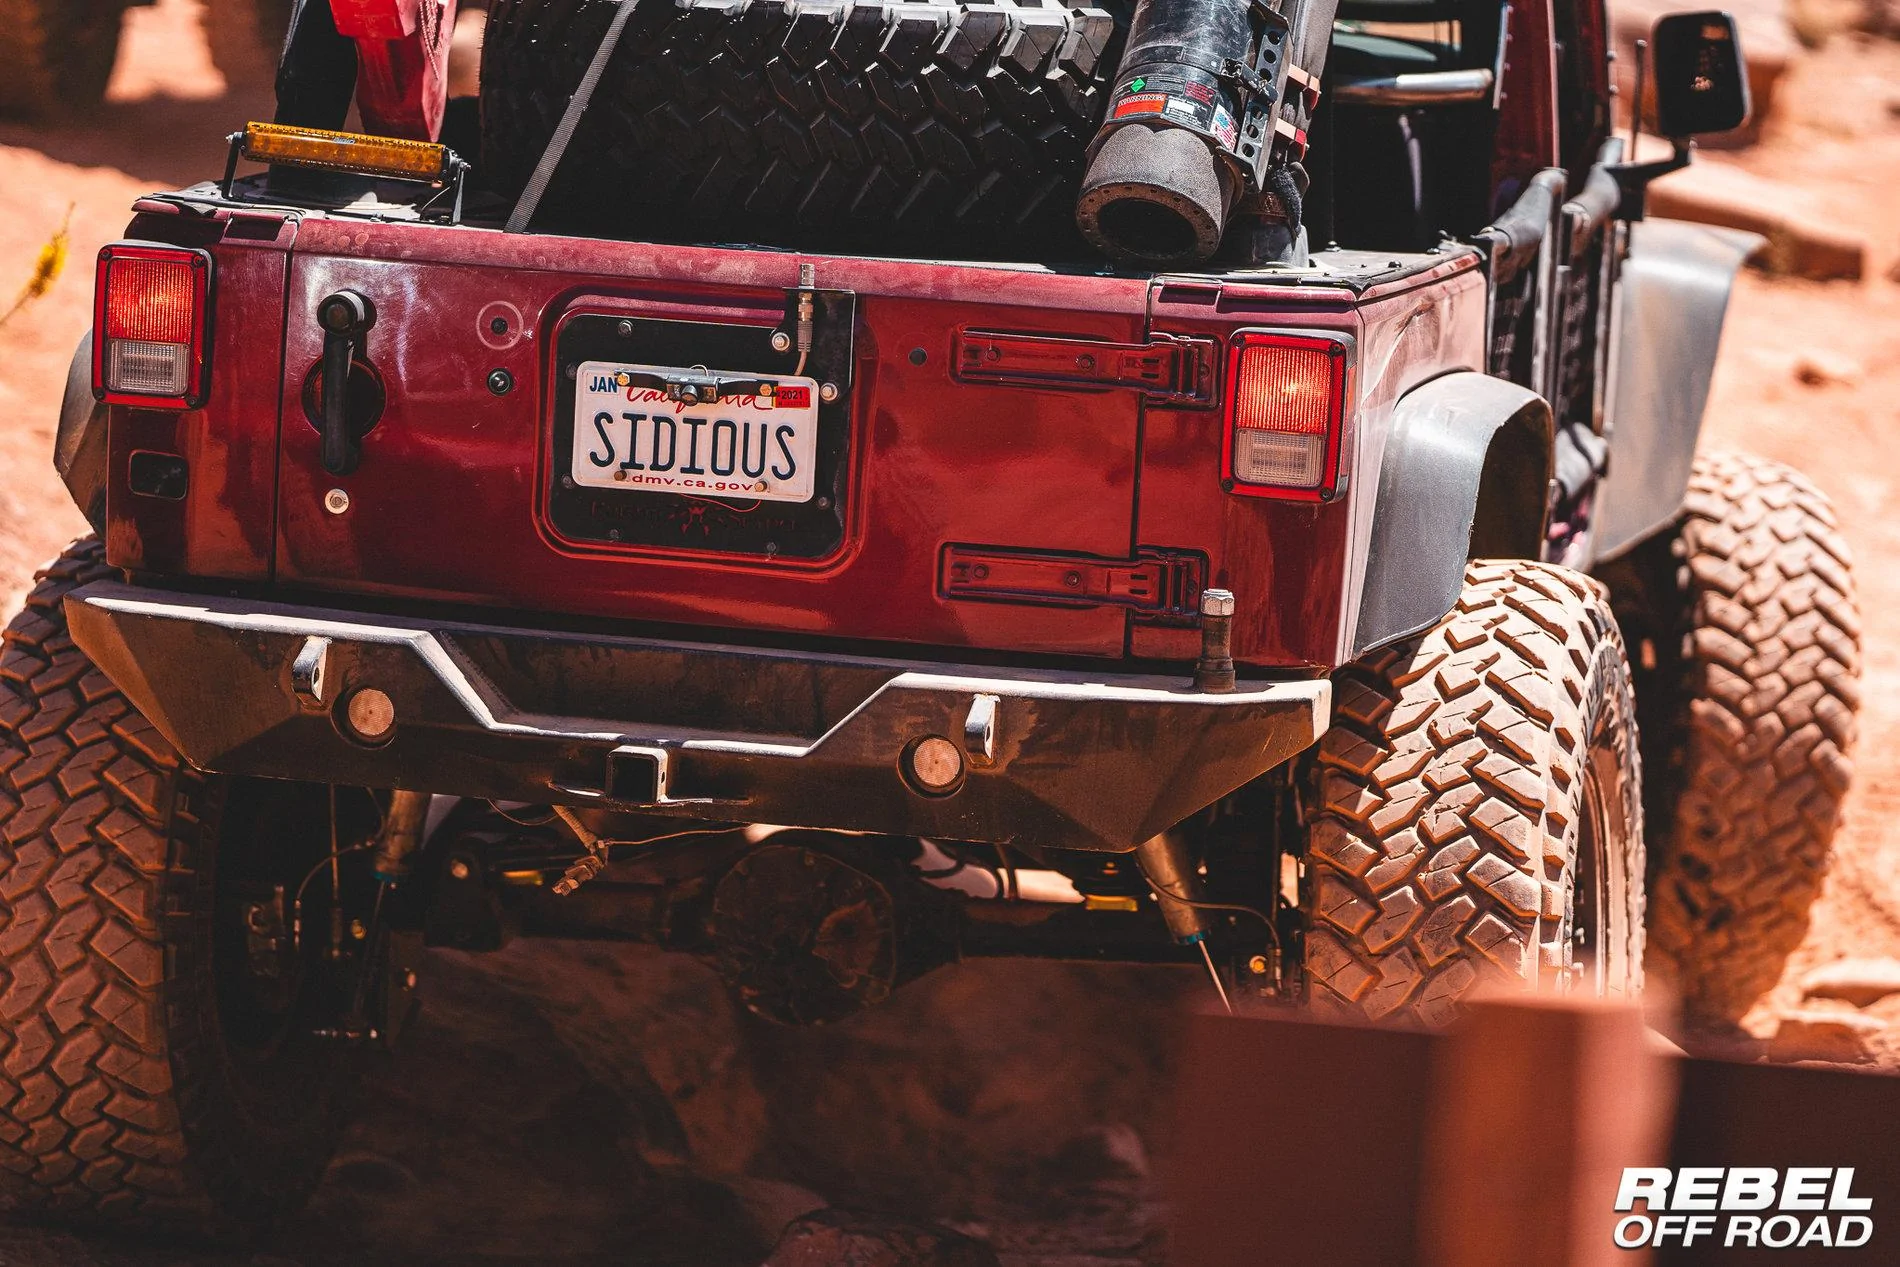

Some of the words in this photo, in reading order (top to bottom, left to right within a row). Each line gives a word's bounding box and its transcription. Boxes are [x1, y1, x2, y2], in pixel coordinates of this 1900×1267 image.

[589, 376, 617, 393] JAN
[781, 390, 804, 400] 2021
[589, 411, 796, 480] SIDIOUS
[631, 474, 753, 491] dmv.ca.gov
